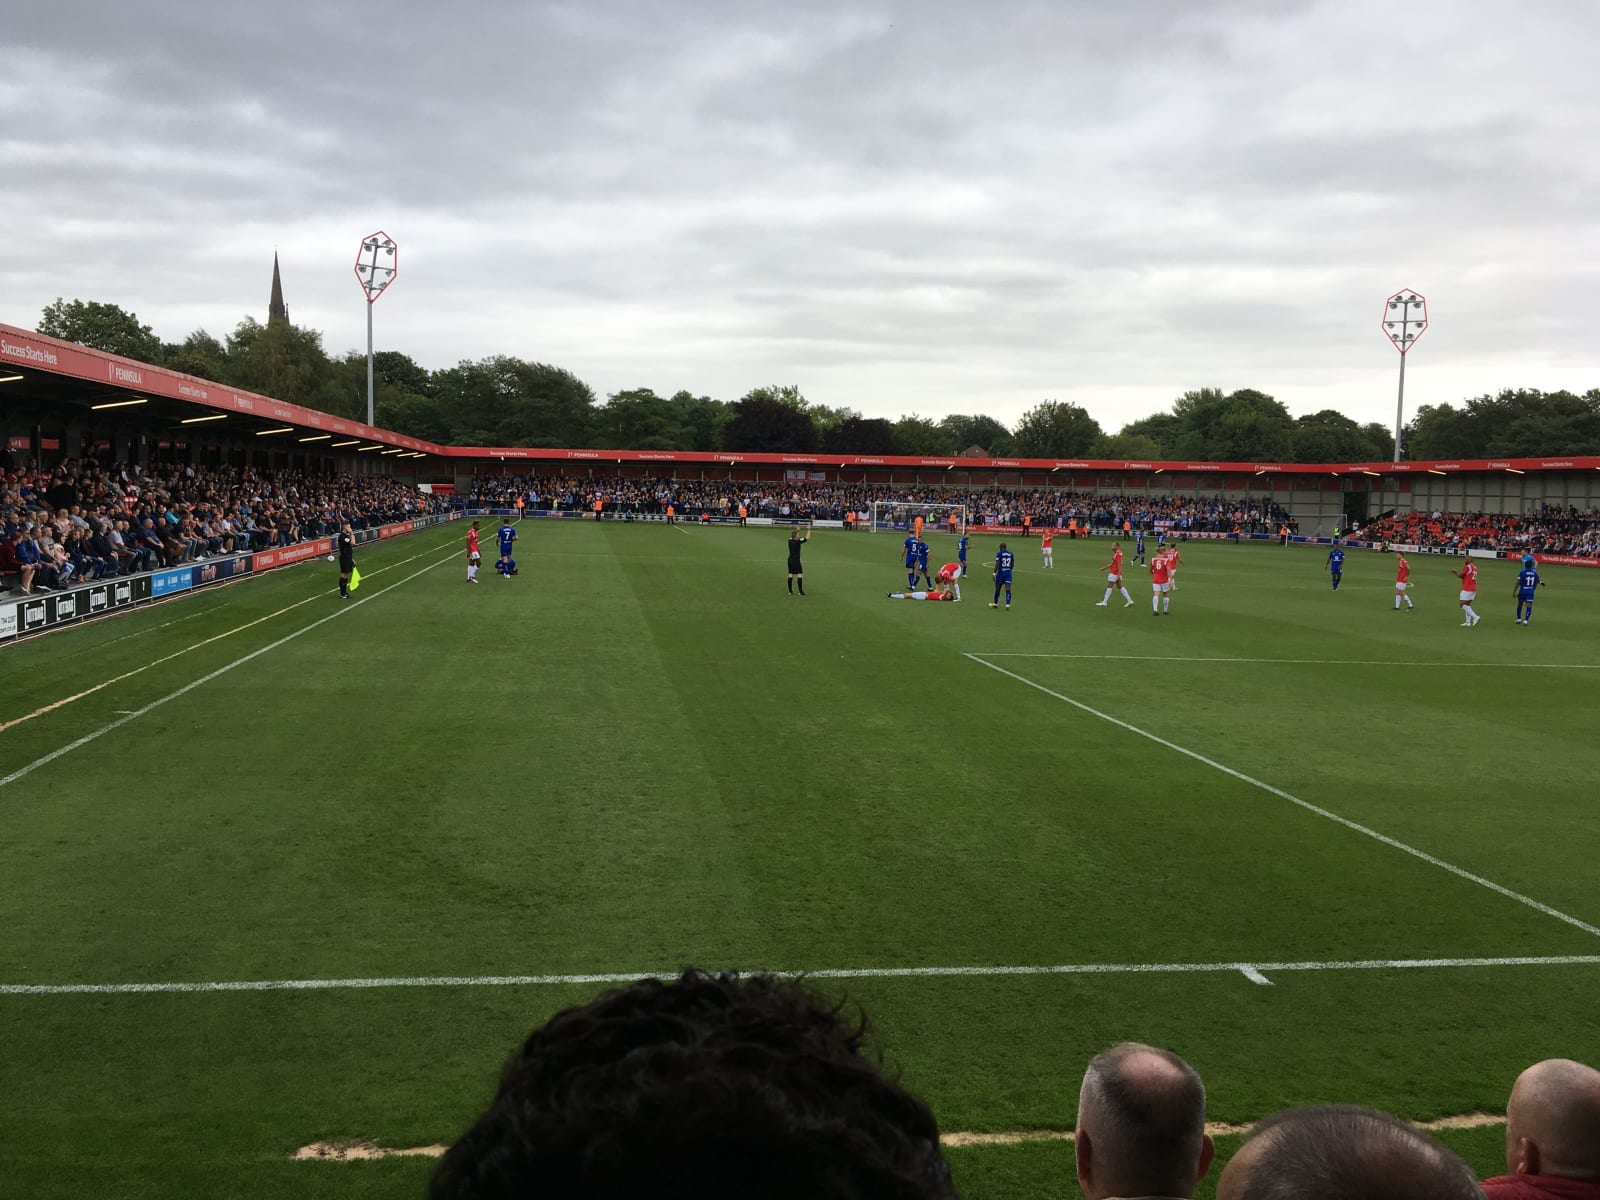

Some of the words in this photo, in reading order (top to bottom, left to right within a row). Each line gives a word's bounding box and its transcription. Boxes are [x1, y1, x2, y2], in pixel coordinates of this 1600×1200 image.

[1, 340, 25, 357] Success
[26, 346, 43, 361] Starts
[44, 350, 57, 364] Here
[115, 367, 142, 384] PENINSULA
[505, 532, 510, 540] 7
[1002, 558, 1011, 567] 32
[1156, 560, 1161, 569] 6
[1526, 576, 1535, 586] 11
